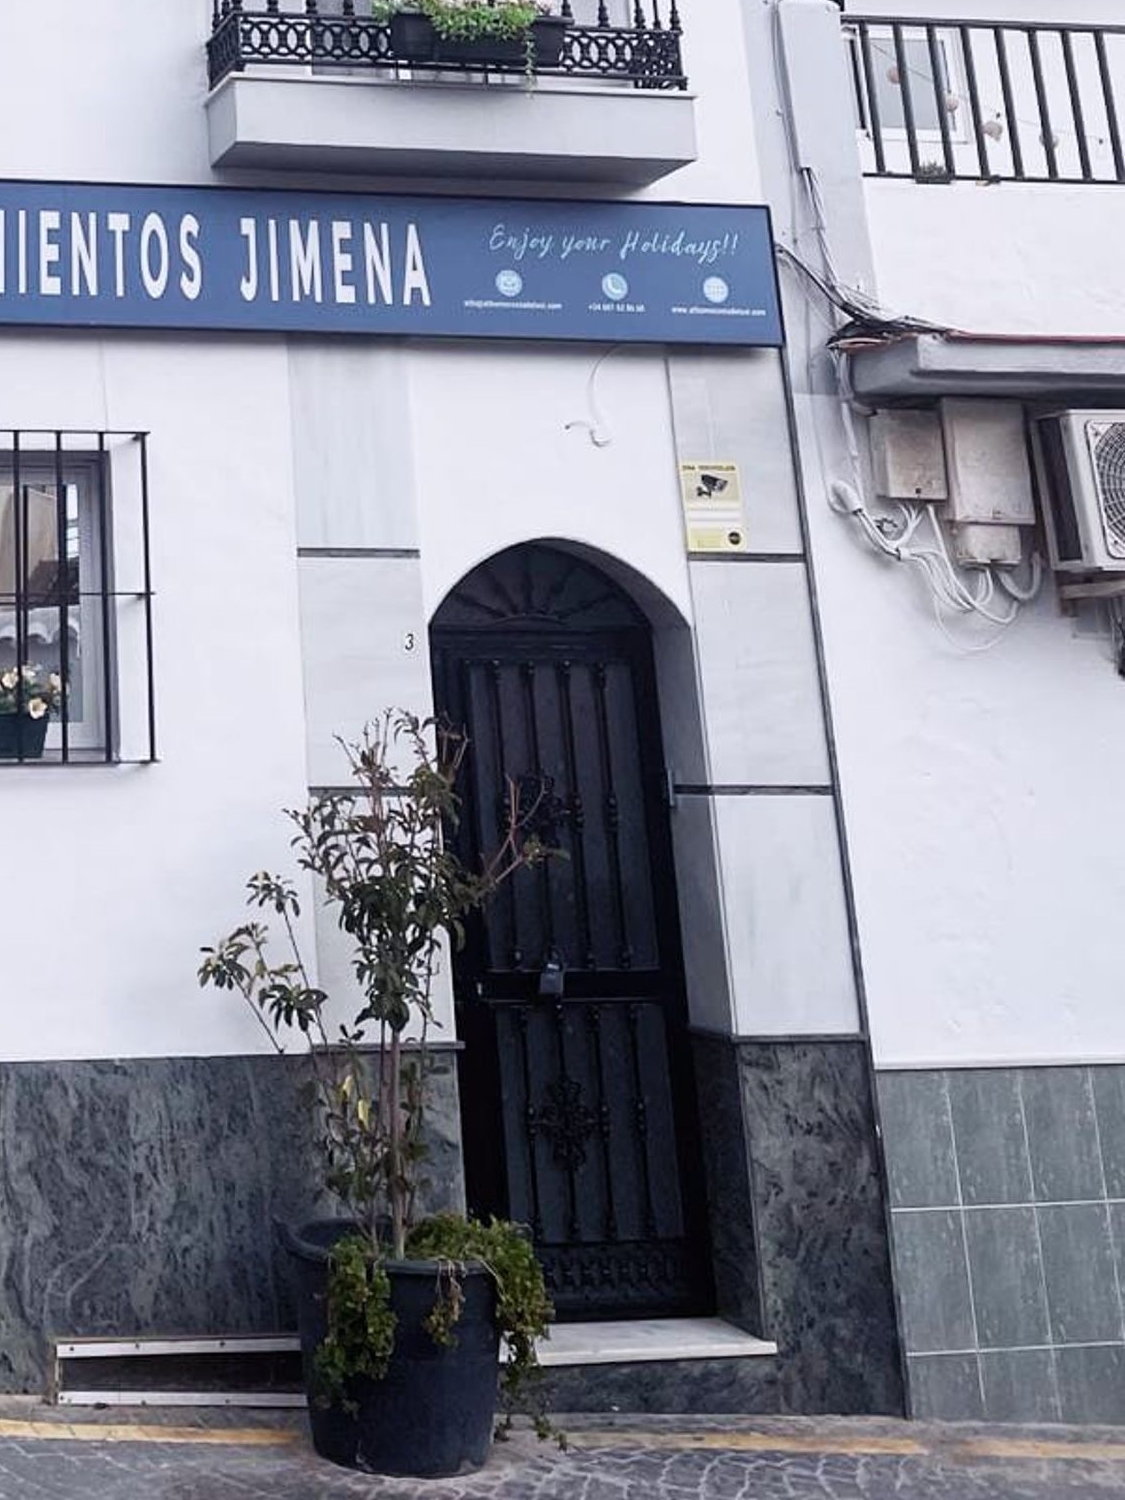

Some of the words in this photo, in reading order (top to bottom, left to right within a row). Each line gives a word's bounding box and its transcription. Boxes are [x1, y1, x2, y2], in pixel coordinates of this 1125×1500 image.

[239, 216, 432, 306] JIMENA
[488, 223, 553, 261] Enjoy
[560, 234, 611, 259] your
[619, 230, 739, 264] Holidays!!
[404, 633, 415, 651] 3
